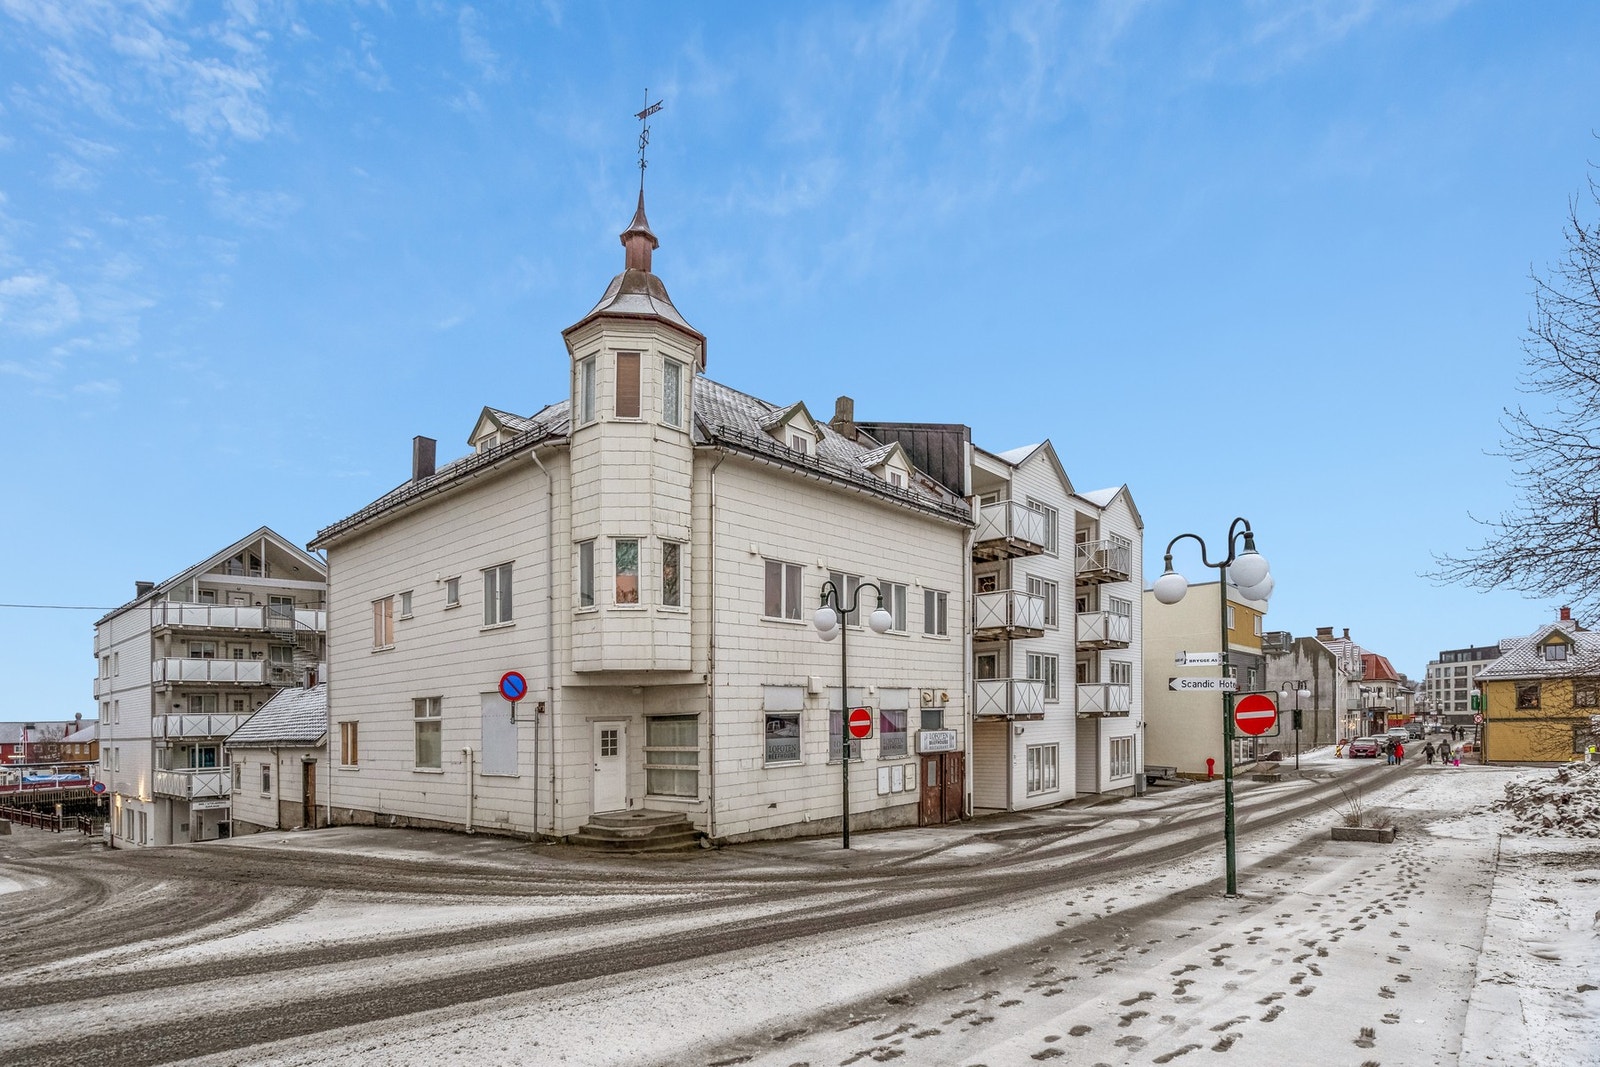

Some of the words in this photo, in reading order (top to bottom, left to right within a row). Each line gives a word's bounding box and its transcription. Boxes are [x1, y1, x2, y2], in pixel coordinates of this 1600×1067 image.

[1181, 680, 1215, 688] Scandic
[929, 732, 949, 741] LOFOTEN
[883, 737, 904, 746] LOFOTEN
[769, 743, 797, 753] LOFOTEN
[768, 752, 797, 760] BEEFHOUSE
